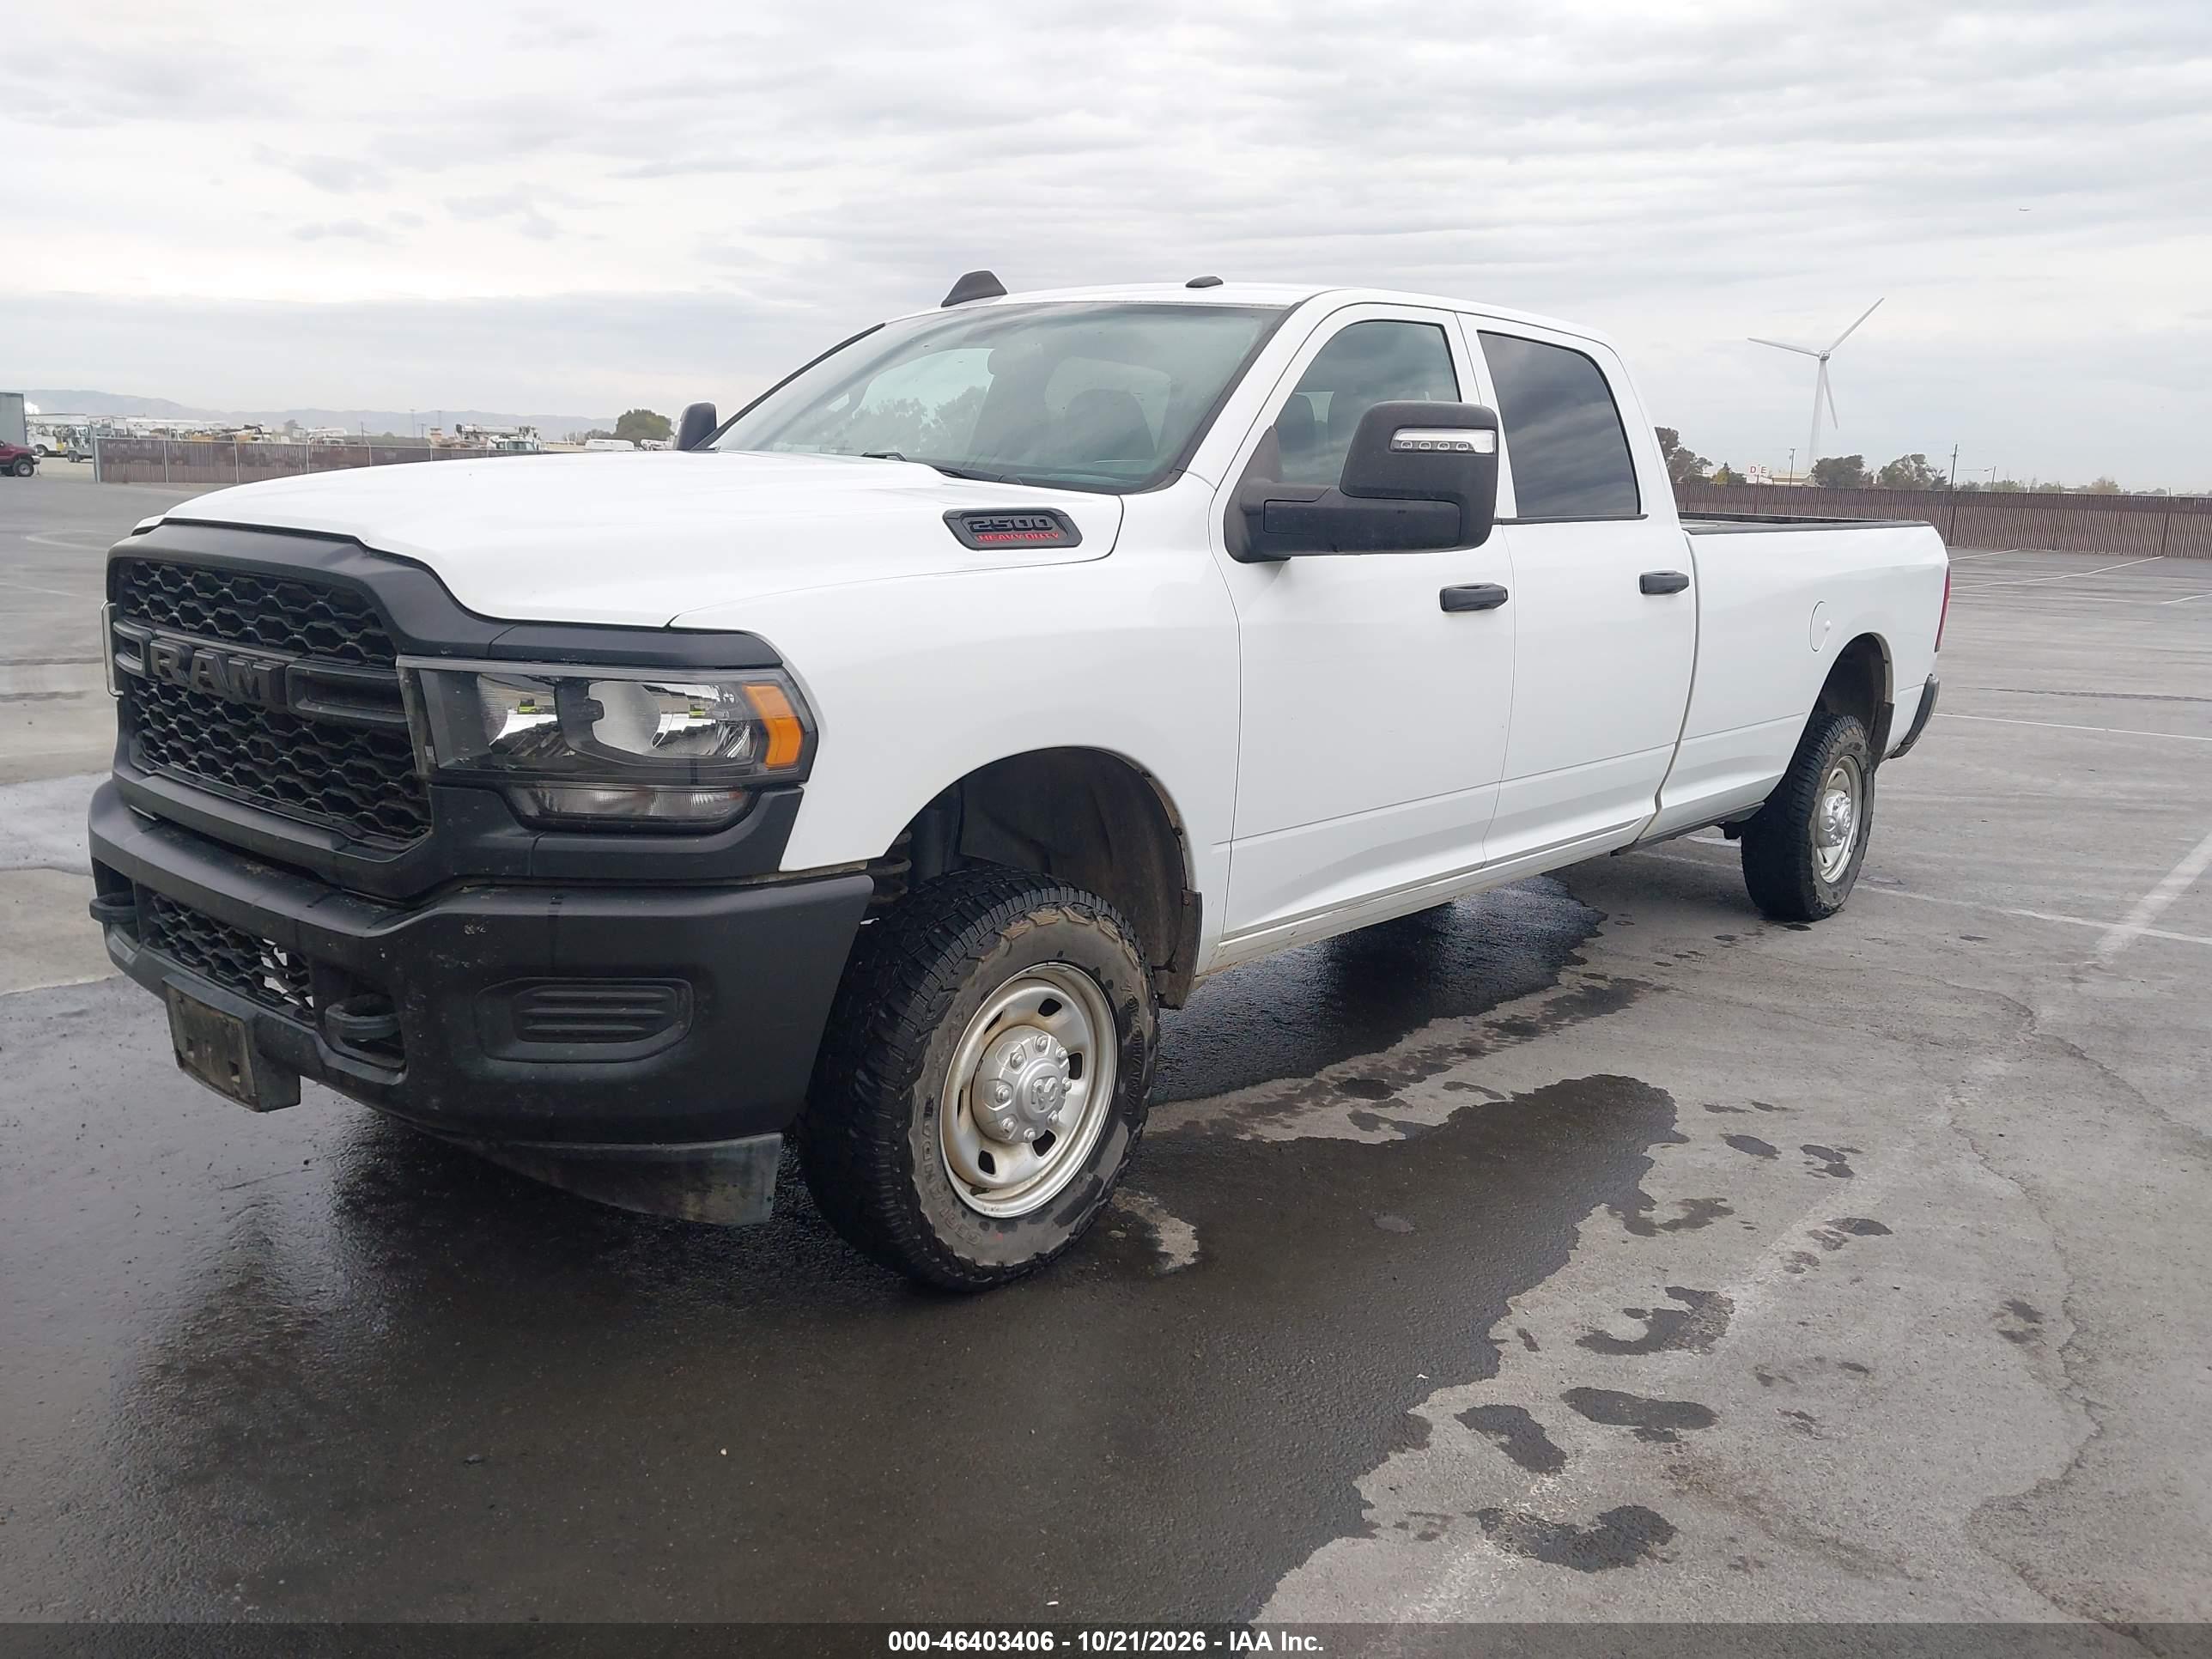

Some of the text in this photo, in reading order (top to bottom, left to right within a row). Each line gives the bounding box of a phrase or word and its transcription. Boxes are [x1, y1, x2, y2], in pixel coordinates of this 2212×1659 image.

[968, 517, 1054, 532] 2500
[977, 532, 1059, 542] HEAVY DUTY
[149, 638, 285, 709] RAM
